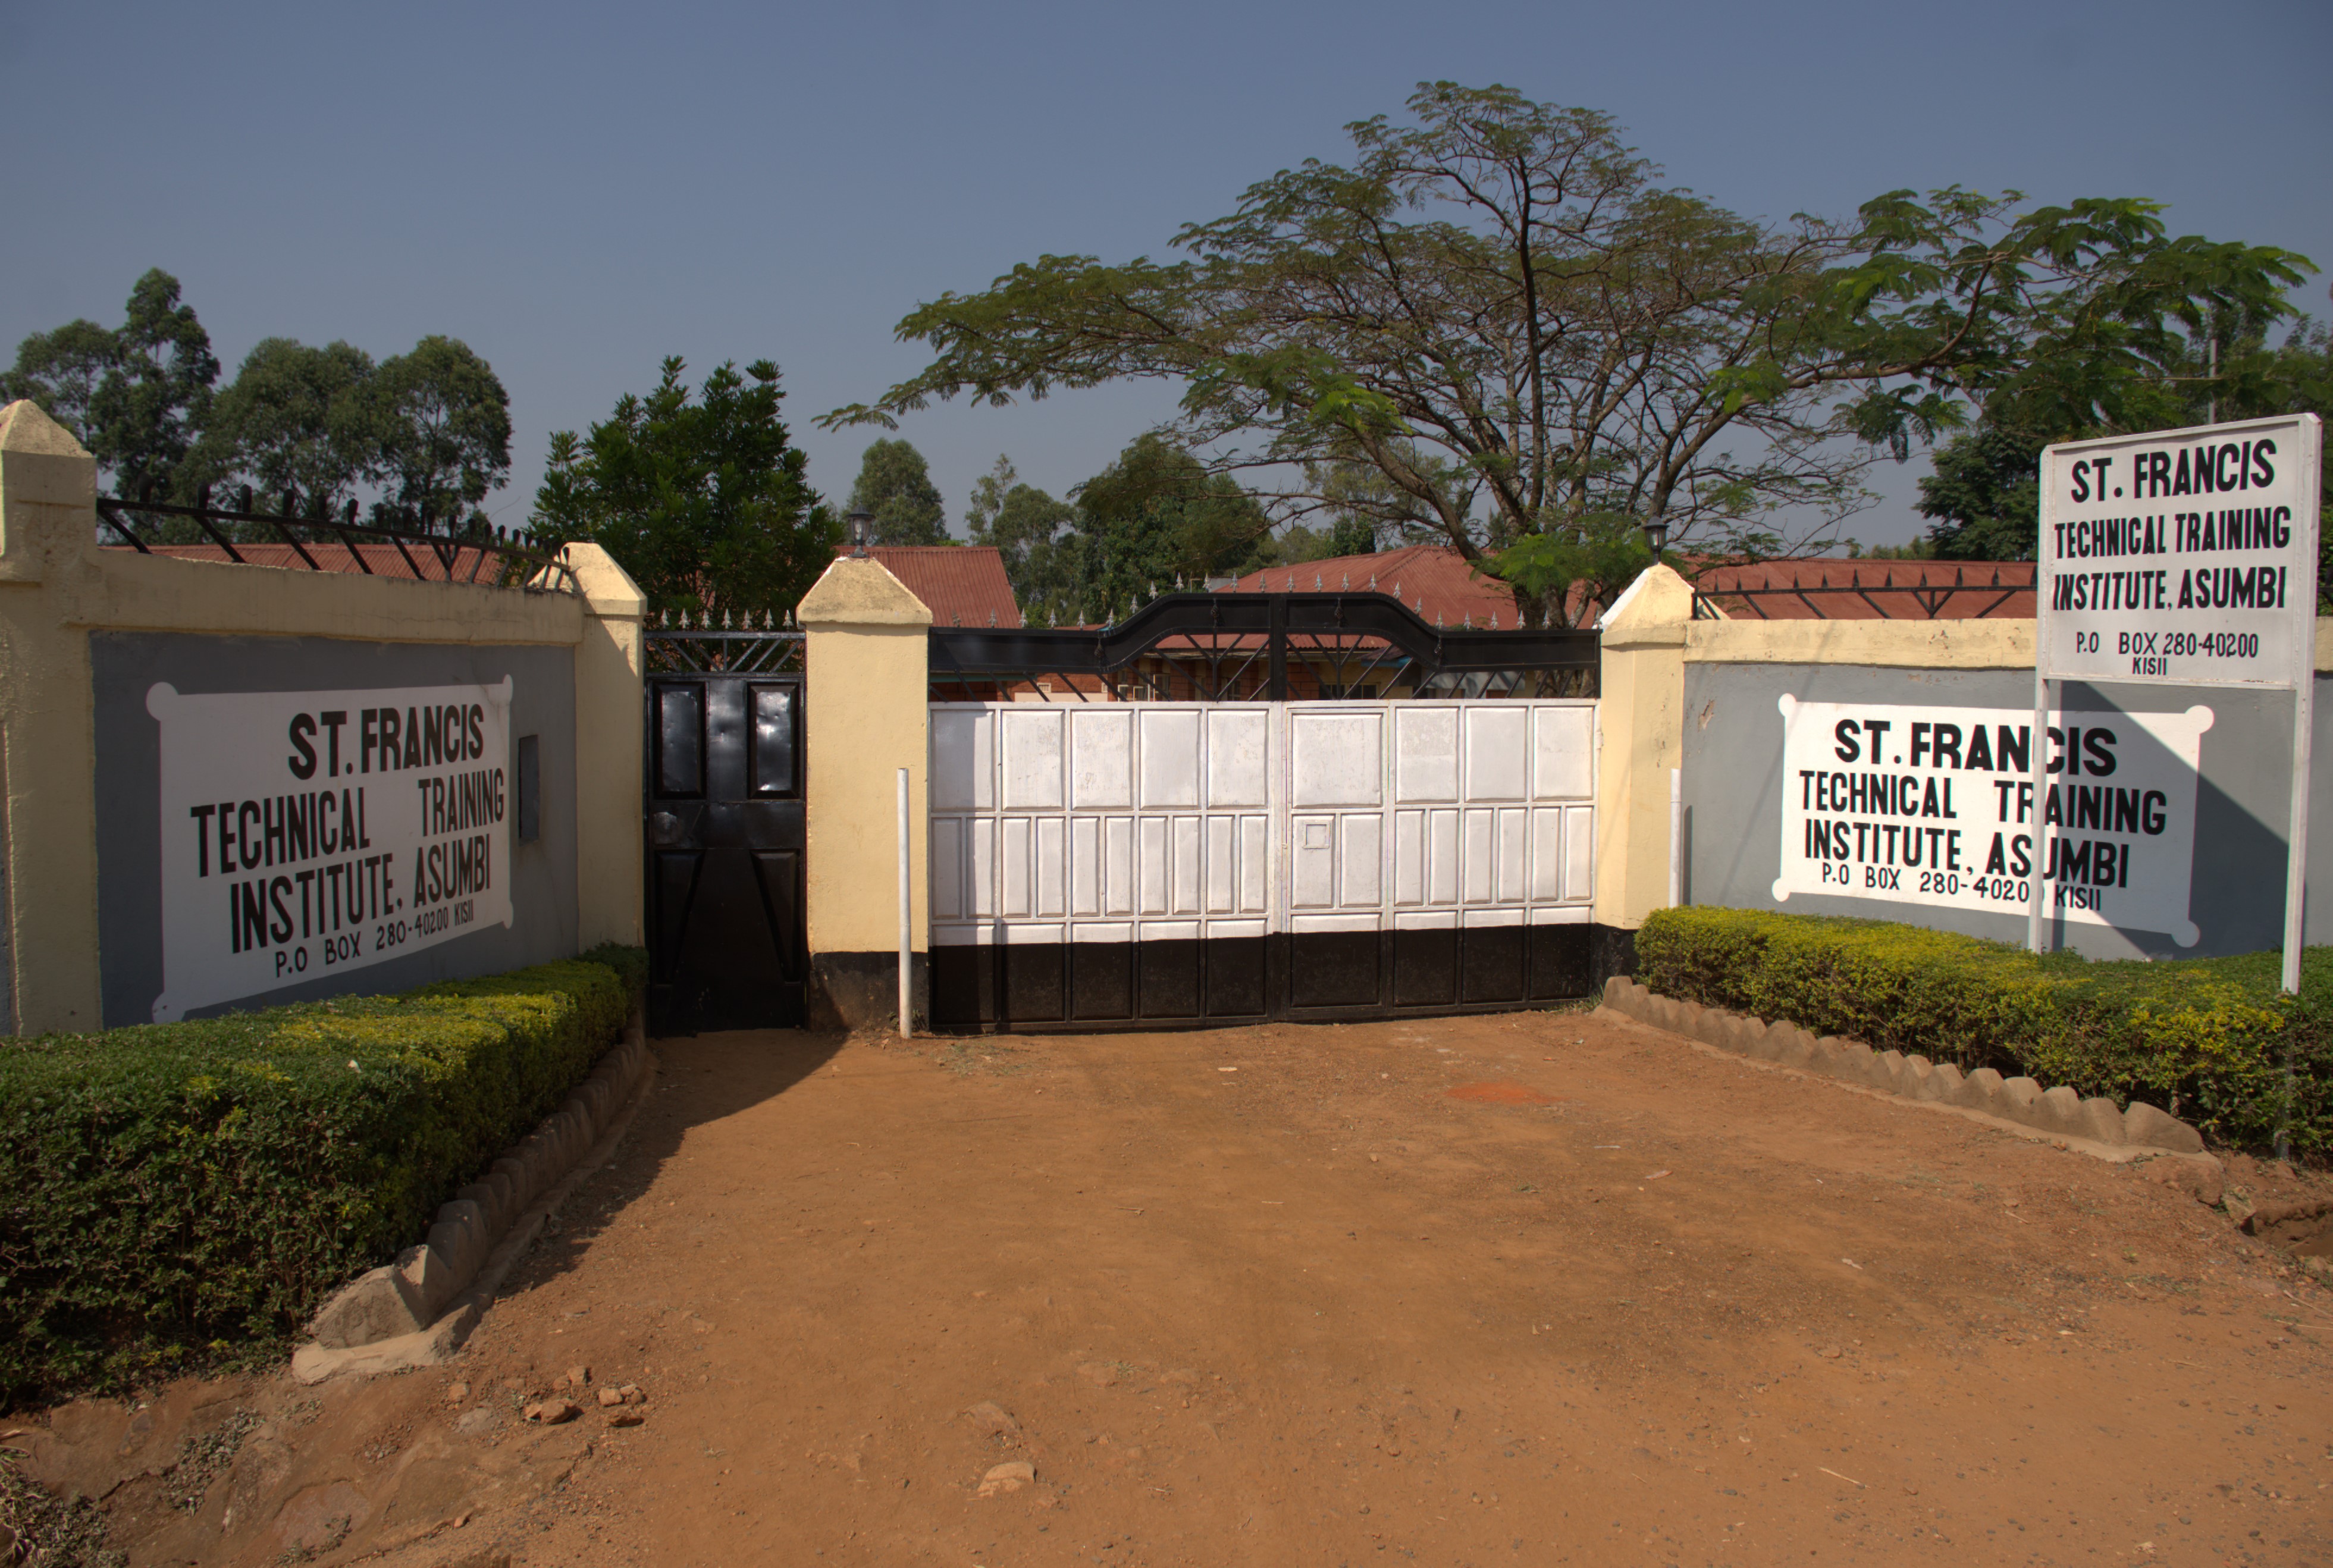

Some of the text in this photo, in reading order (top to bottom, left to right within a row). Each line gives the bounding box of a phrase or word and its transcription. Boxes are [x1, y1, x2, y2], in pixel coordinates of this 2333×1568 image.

[2055, 506, 2291, 559] TECHNICAL TRAINING
[2053, 566, 2287, 611] INSTITUTE, ASUMBI
[2076, 631, 2259, 658] P.O BOX 280-40200
[2132, 657, 2167, 676] KISII
[190, 768, 504, 877] TECHNICAL TRAINING
[1799, 770, 2167, 836] TECHNICAL TRAINING
[1805, 819, 1974, 876] INSTITUTE,
[230, 833, 491, 954] INSTITUTE, ASUMBI
[1822, 862, 2101, 911] P.O BOX 280-4020 KISII
[275, 899, 474, 978] P.O BOX 280-40200 KISII
